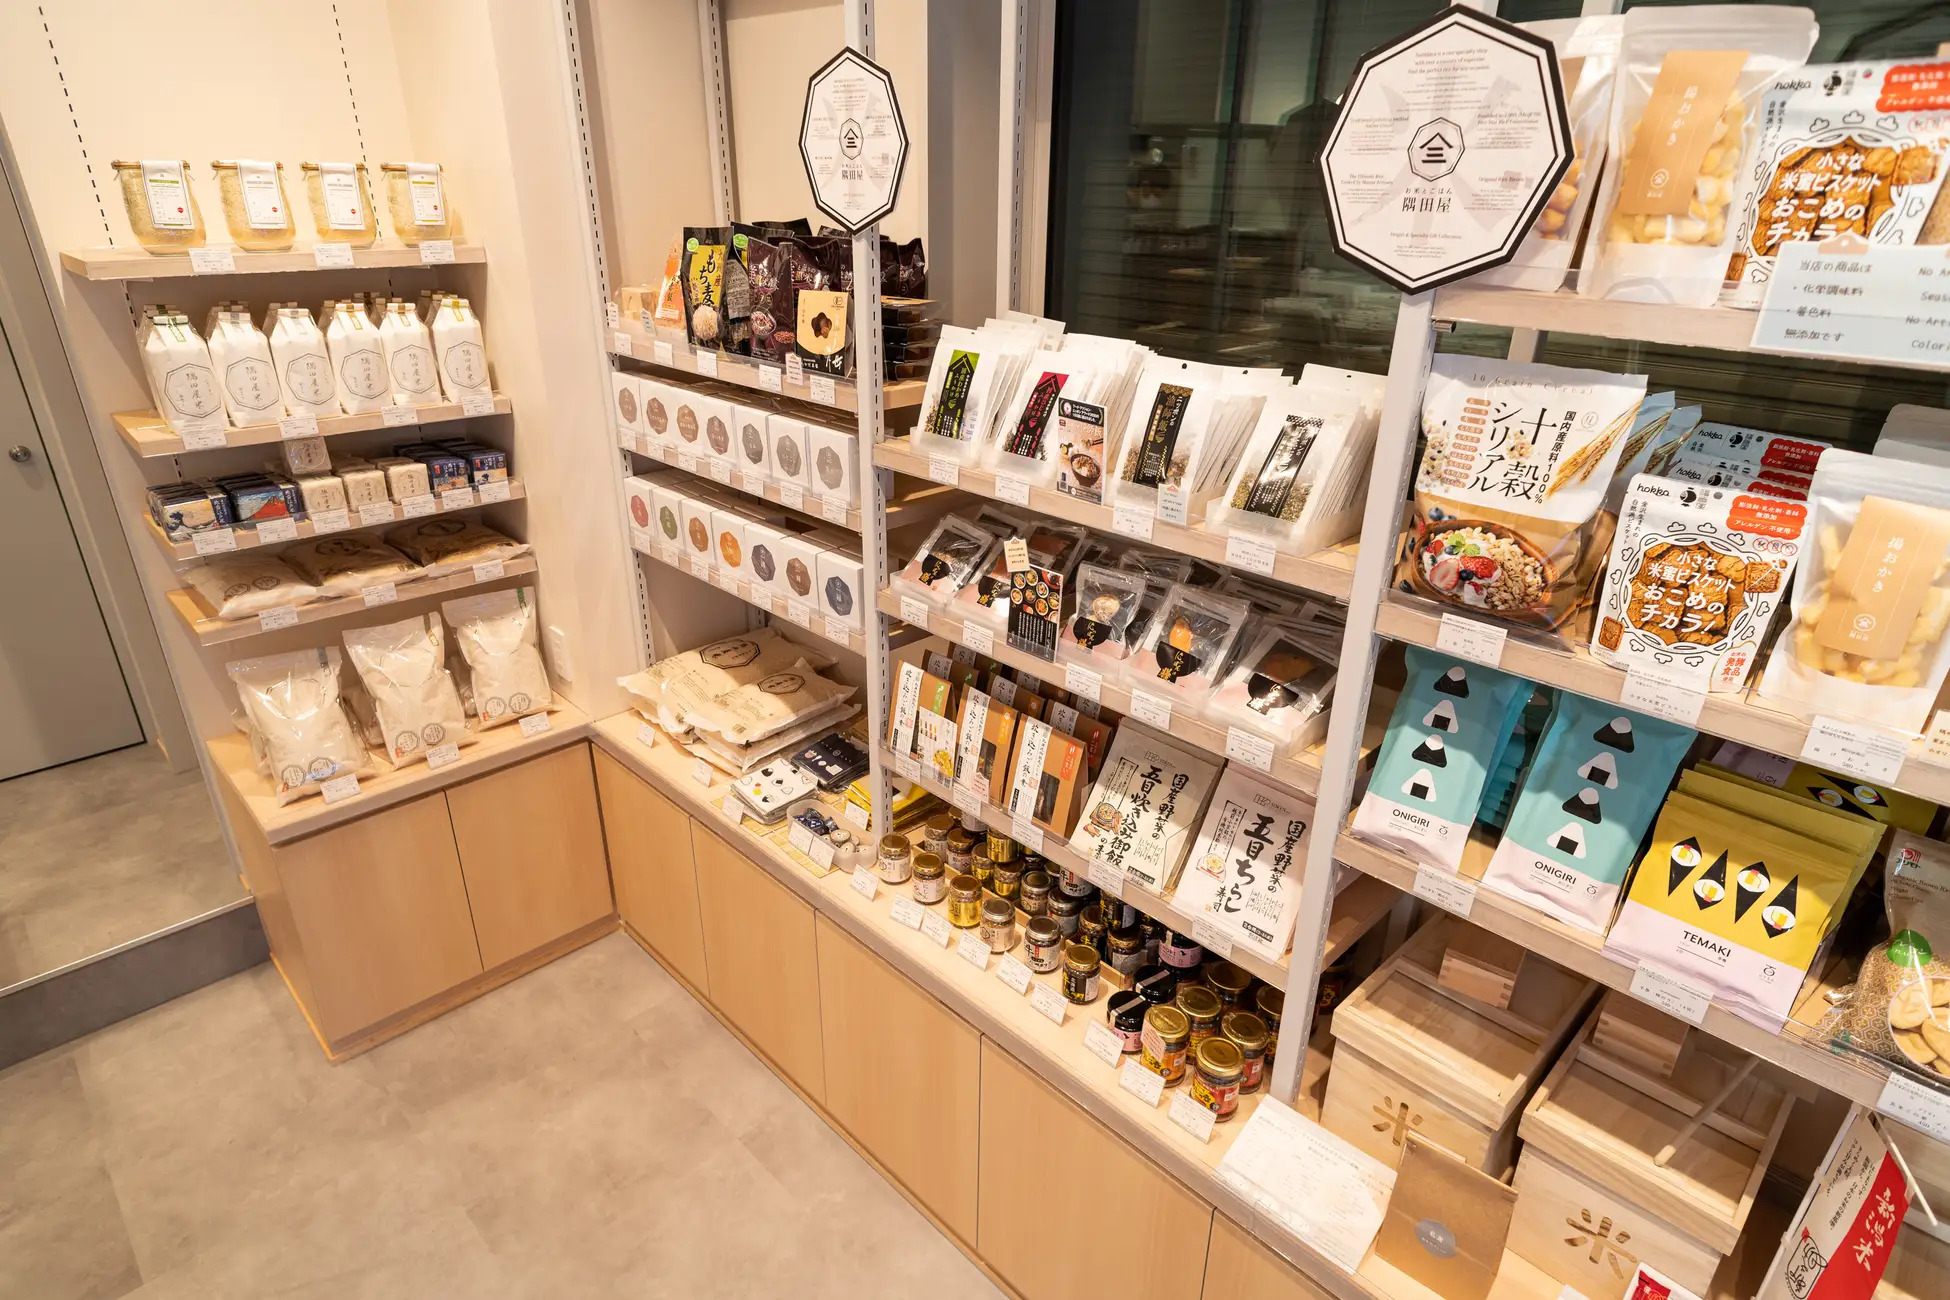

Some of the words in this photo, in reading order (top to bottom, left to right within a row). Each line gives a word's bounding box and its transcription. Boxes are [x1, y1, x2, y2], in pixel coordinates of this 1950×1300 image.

[1815, 151, 1865, 170] 小さな
[1779, 172, 1882, 193] 米蜜ビスケット
[1402, 197, 1451, 213] 隅田屋
[1771, 196, 1867, 221] おこめの
[699, 248, 716, 307] もち麦
[1799, 259, 1873, 274] 当店の商品は
[1918, 267, 1933, 277] No
[1905, 315, 1920, 325] No
[1783, 327, 1845, 343] 無添加です
[1698, 429, 1723, 440] hokka
[1467, 401, 1524, 493] シリアル
[1498, 407, 1558, 500] 十穀
[1636, 482, 1670, 497] hokka
[1676, 551, 1718, 571] 小さな
[1648, 561, 1737, 595] 米蜜ビスケット
[1642, 583, 1726, 615] おこめの
[1721, 666, 1741, 677] 食品
[1726, 656, 1747, 668] 発酵
[1106, 764, 1163, 866] 五目炊き込み御飯
[1151, 773, 1190, 841] 国産野菜の
[1392, 808, 1430, 828] ONIGIRI
[1223, 812, 1275, 914] 五目ちらし
[1267, 819, 1307, 894] 国産野菜の
[1534, 861, 1577, 885] ONIGIRI
[1212, 885, 1227, 913] 寿司
[1683, 929, 1732, 958] TEMAKI
[1563, 1207, 1638, 1281] 米
